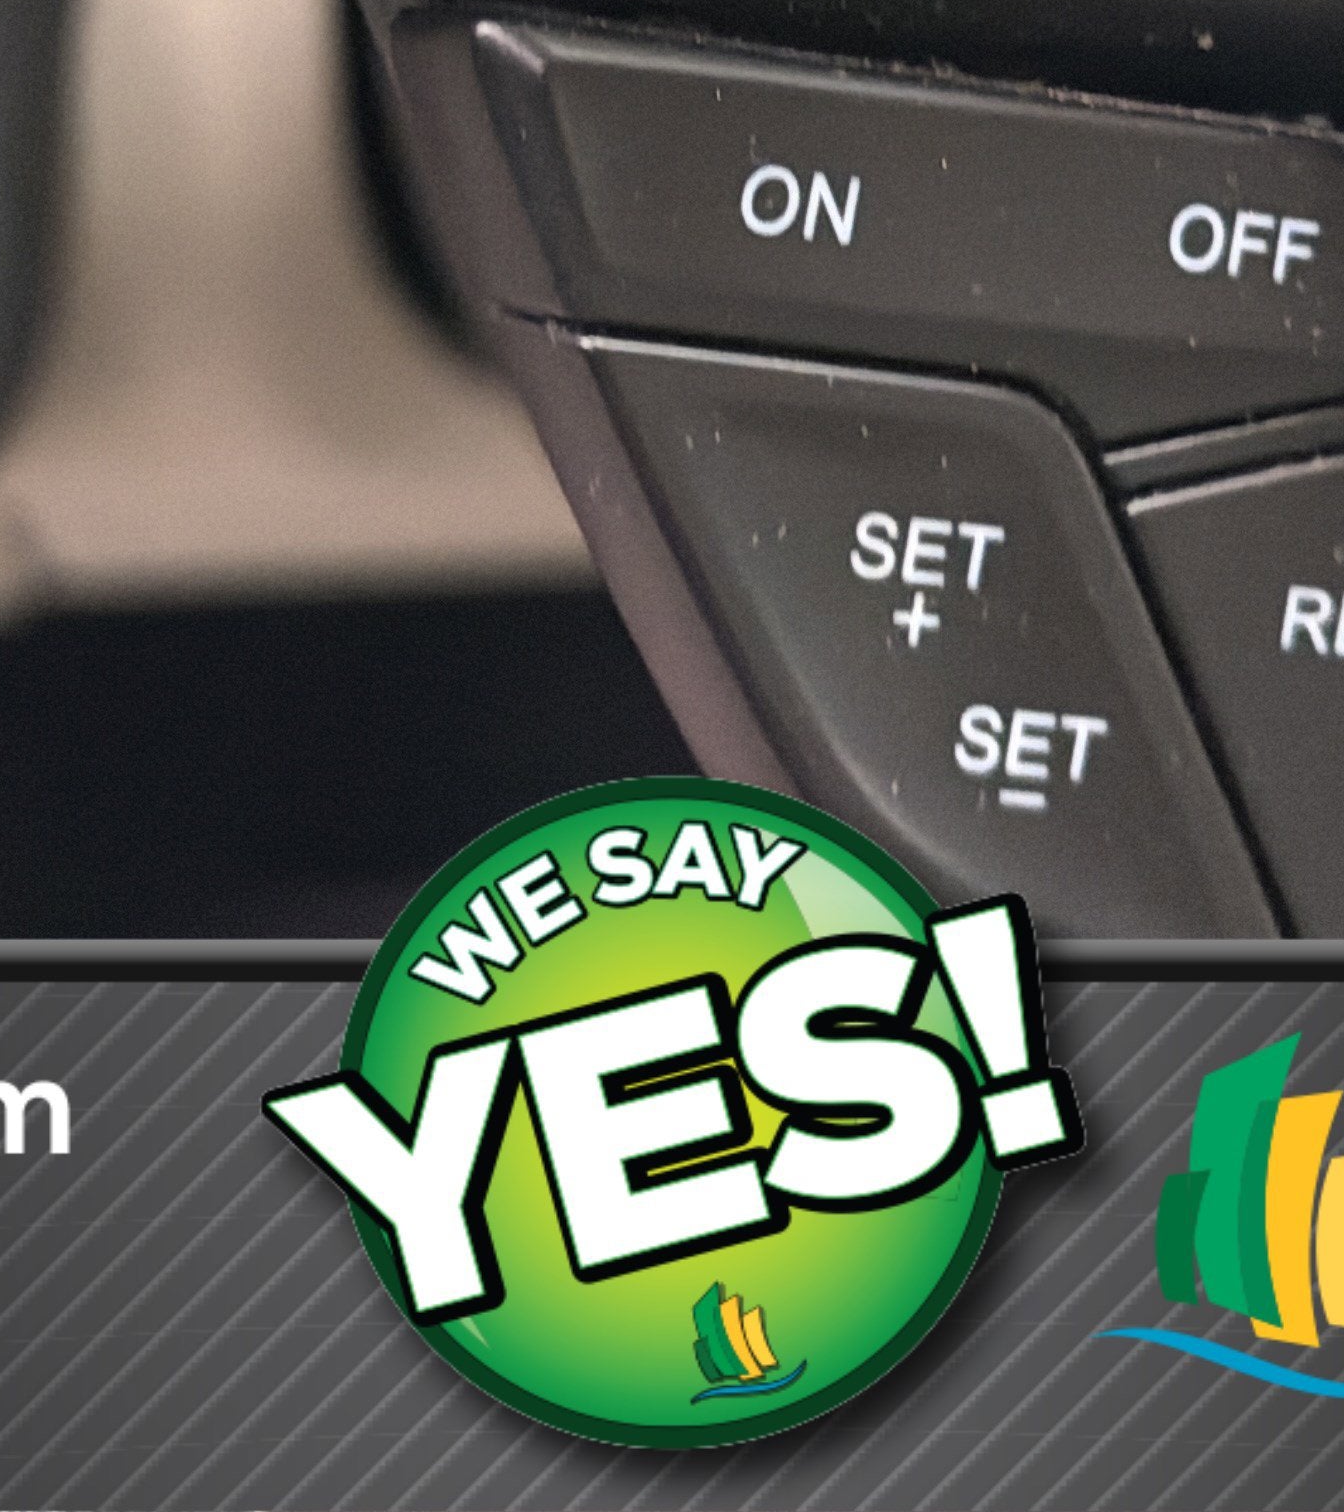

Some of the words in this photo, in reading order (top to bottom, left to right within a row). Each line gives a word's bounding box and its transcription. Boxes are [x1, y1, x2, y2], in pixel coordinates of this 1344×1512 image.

[741, 165, 860, 245] ON
[1170, 204, 1319, 284] OFF
[851, 512, 1004, 590] SET
[955, 705, 1107, 781] SET
